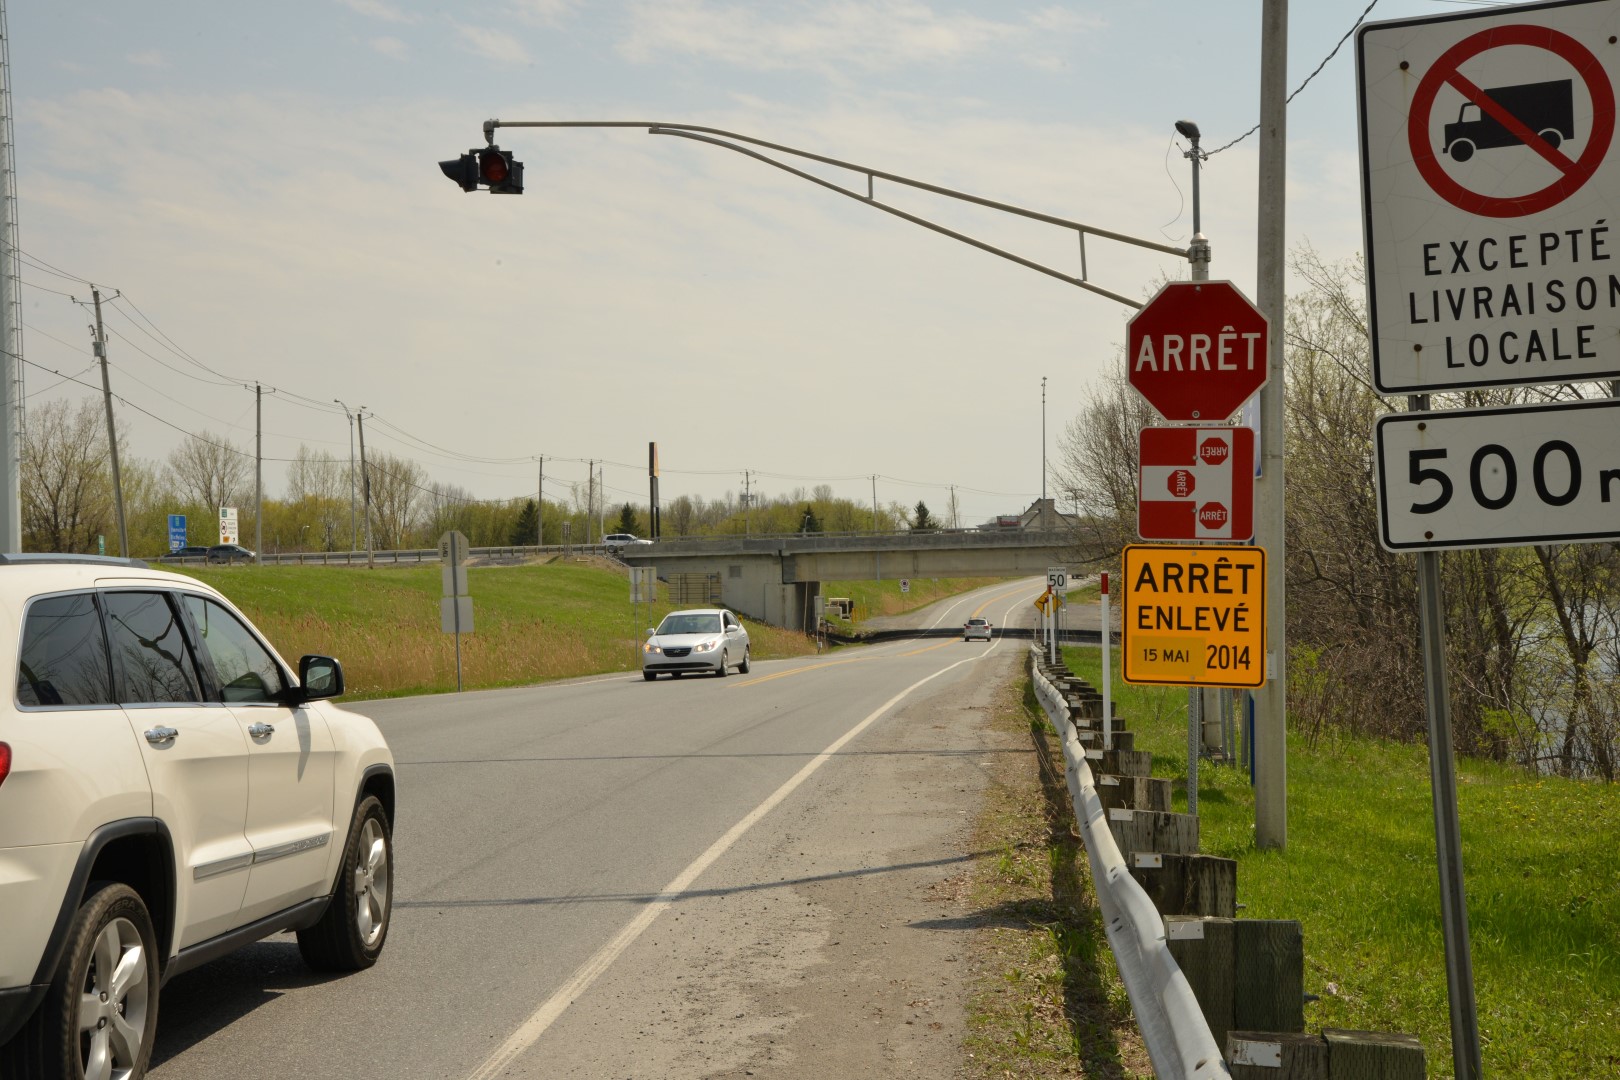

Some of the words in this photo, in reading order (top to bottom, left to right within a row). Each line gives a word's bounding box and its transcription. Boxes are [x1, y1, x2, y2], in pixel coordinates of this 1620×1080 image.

[1423, 219, 1611, 276] EXCEPTÉ
[1409, 274, 1620, 324] LIVRAISON
[1135, 325, 1261, 372] ARRÊT
[1445, 325, 1597, 368] LOCALE
[1200, 446, 1229, 458] ARRÊT
[1176, 470, 1186, 497] ARRÊT
[1409, 440, 1582, 514] 500
[1200, 509, 1227, 521] ARRÊT
[1050, 574, 1064, 587] 50
[1134, 557, 1255, 594] ARRÊT
[1138, 602, 1250, 632] ENLEVÉ
[1143, 648, 1158, 662] 15
[1163, 649, 1189, 663] MAI
[1206, 644, 1251, 670] 2014
